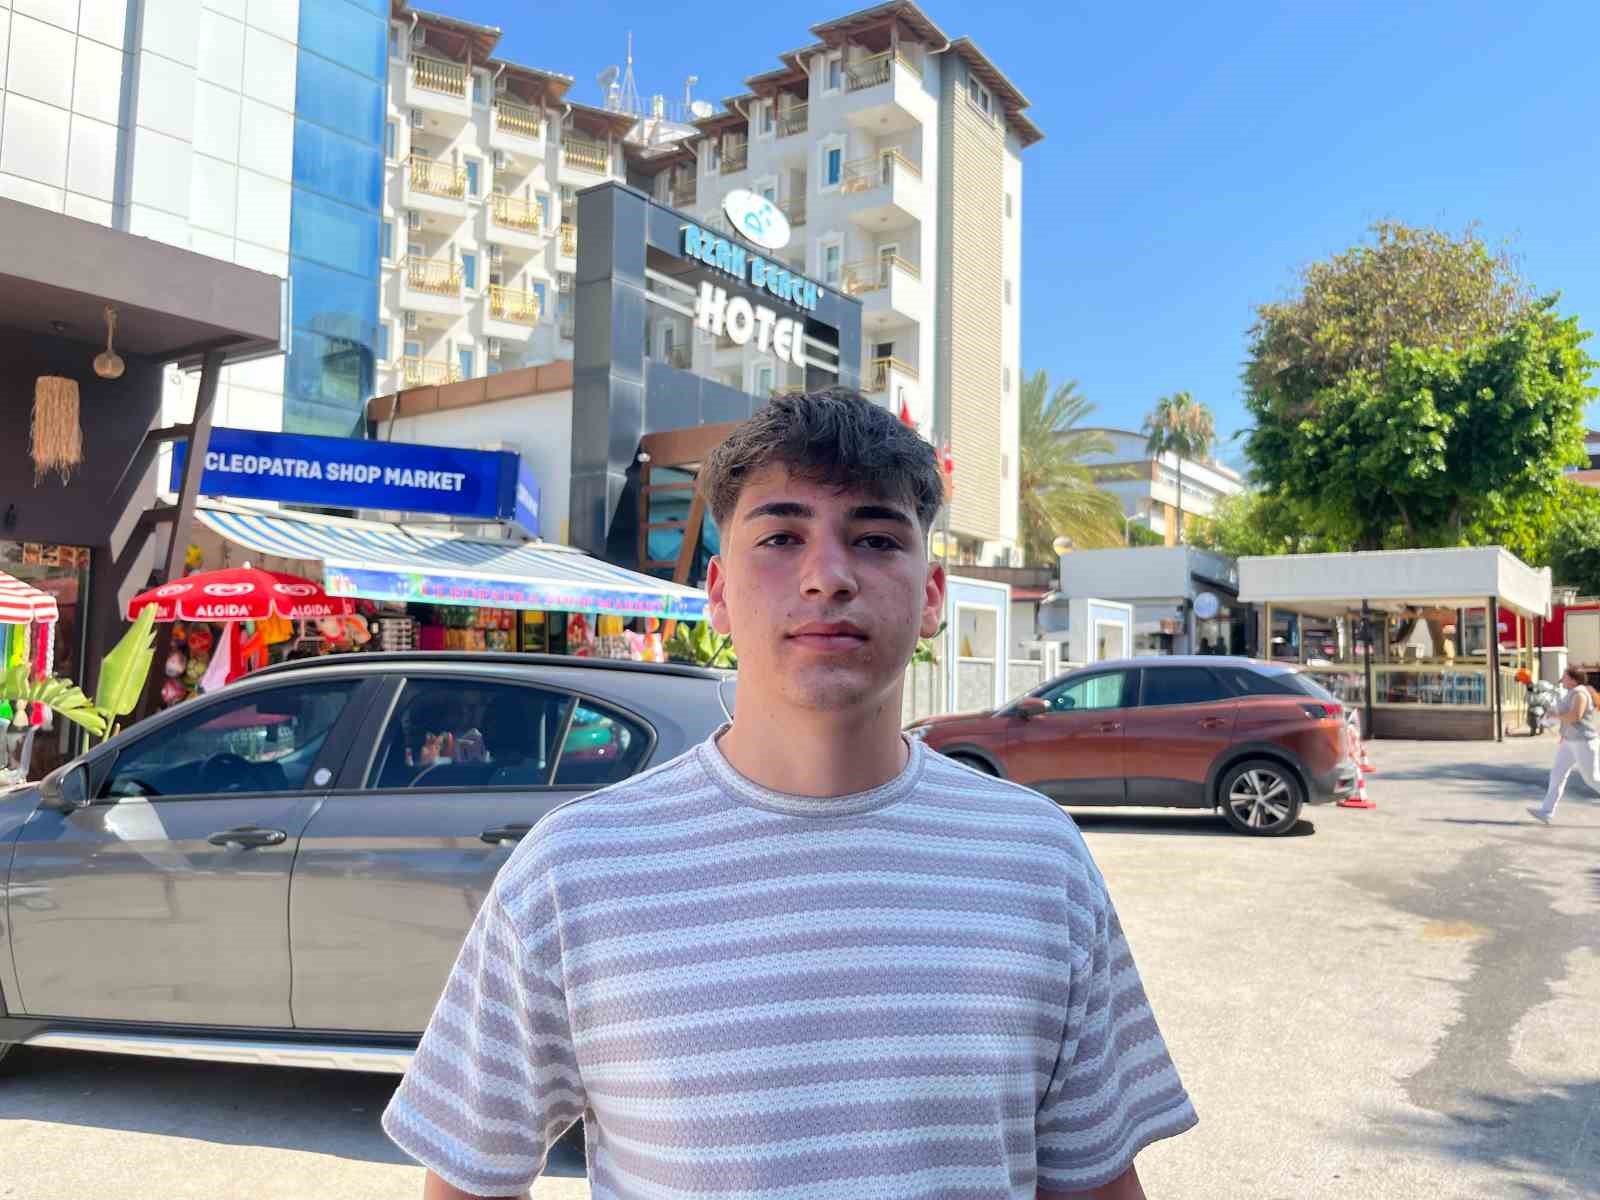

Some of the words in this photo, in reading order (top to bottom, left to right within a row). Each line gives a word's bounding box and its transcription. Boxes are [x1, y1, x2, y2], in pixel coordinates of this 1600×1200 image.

[697, 281, 806, 368] HOTEL
[205, 451, 322, 480] CLEOPATRA
[326, 463, 381, 485] SHOP
[385, 467, 465, 492] MARKET
[196, 604, 249, 617] ALGIDA
[290, 604, 332, 616] ALGIDA
